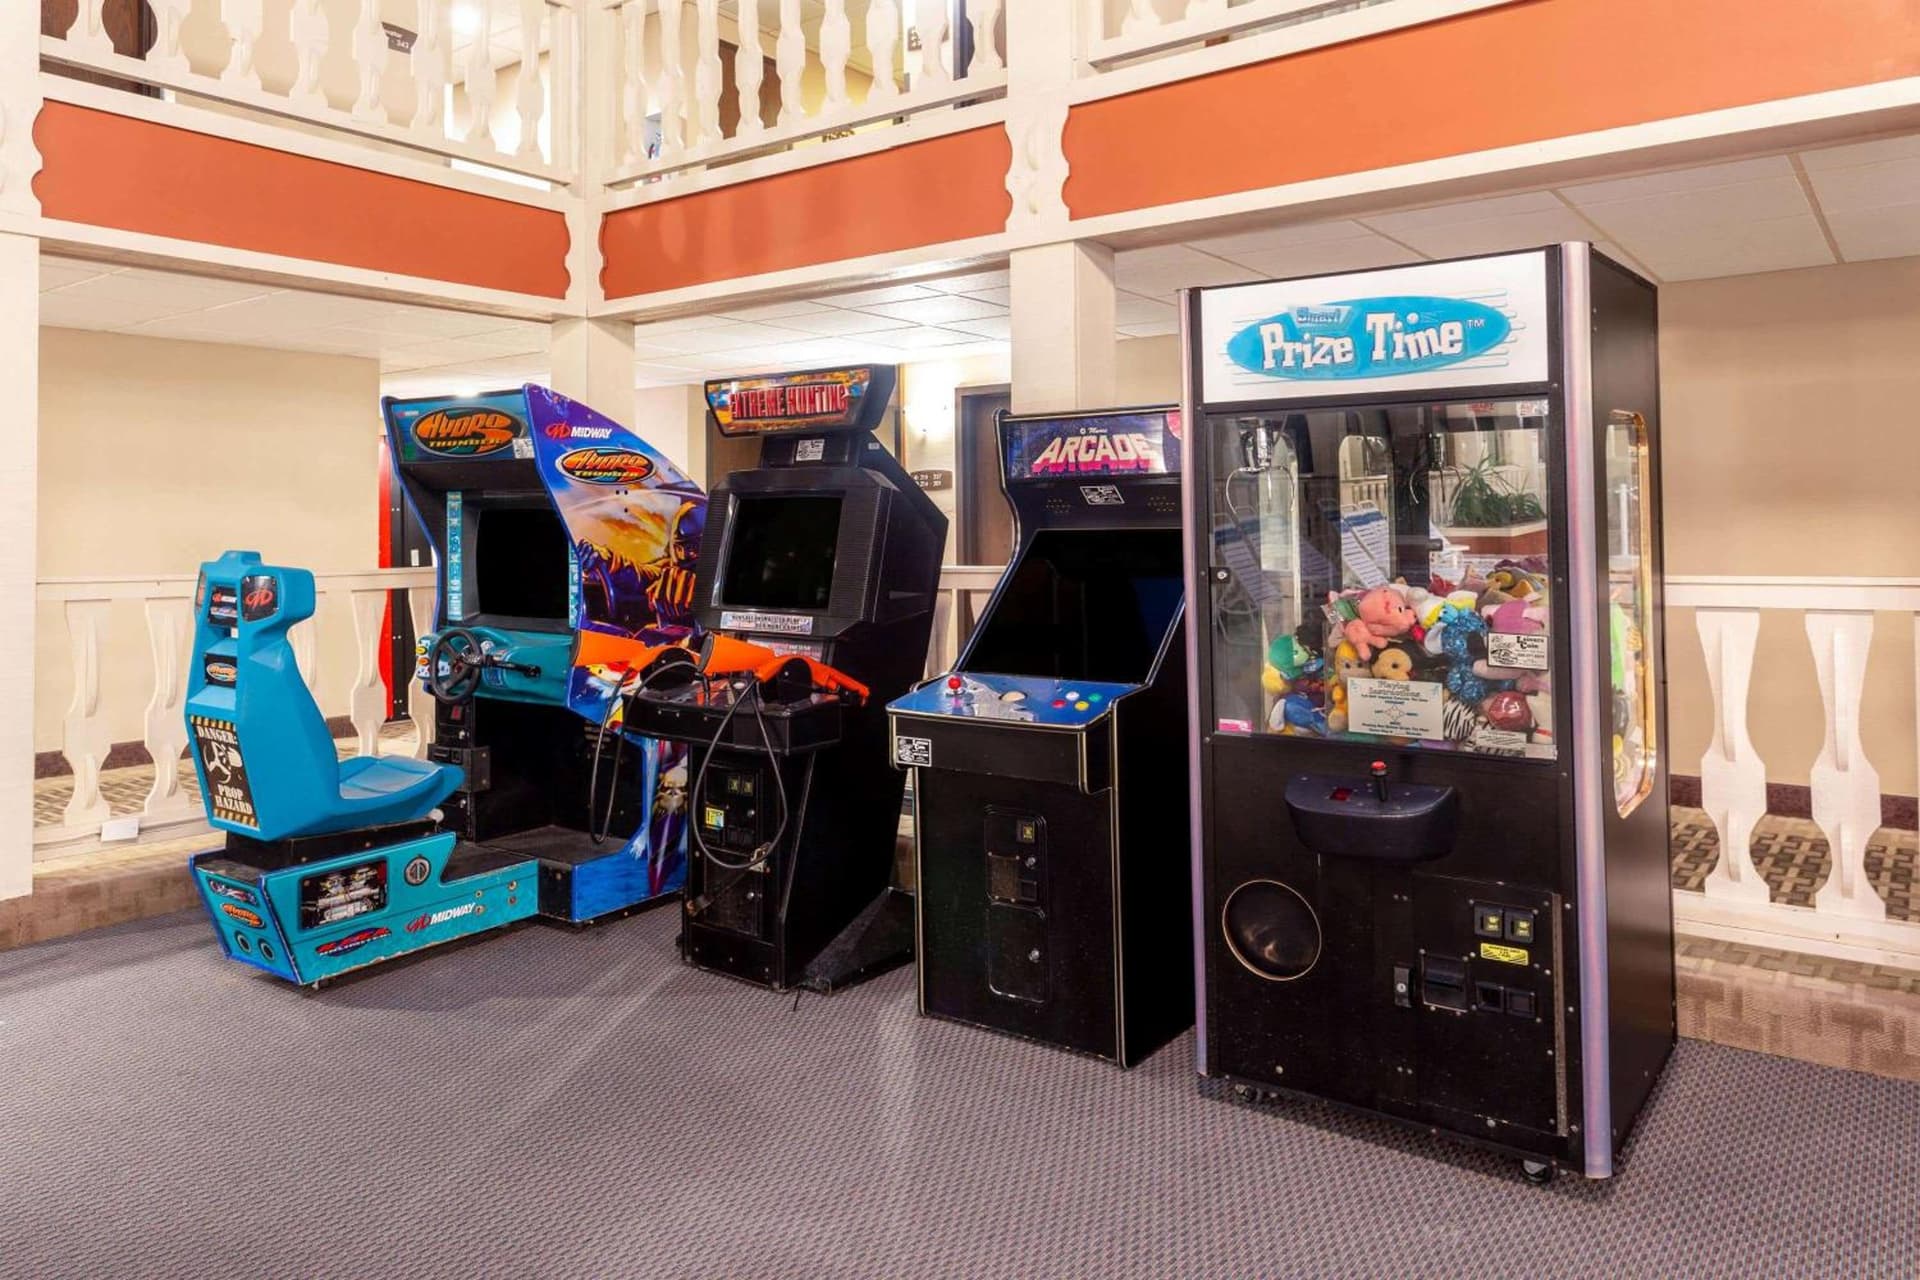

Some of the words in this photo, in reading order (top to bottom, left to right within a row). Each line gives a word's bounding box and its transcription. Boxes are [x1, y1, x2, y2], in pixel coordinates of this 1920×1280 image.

[1259, 322, 1355, 370] Prize
[1366, 312, 1464, 361] Time
[729, 387, 785, 418] EXTREME
[785, 383, 850, 416] HUNTING
[570, 426, 613, 439] MIDWAY
[1032, 433, 1154, 472] ARCADE
[197, 725, 239, 745] DANGER:
[217, 783, 244, 801] PROP
[214, 795, 254, 815] HAZARD
[430, 902, 476, 925] MIDWAY
